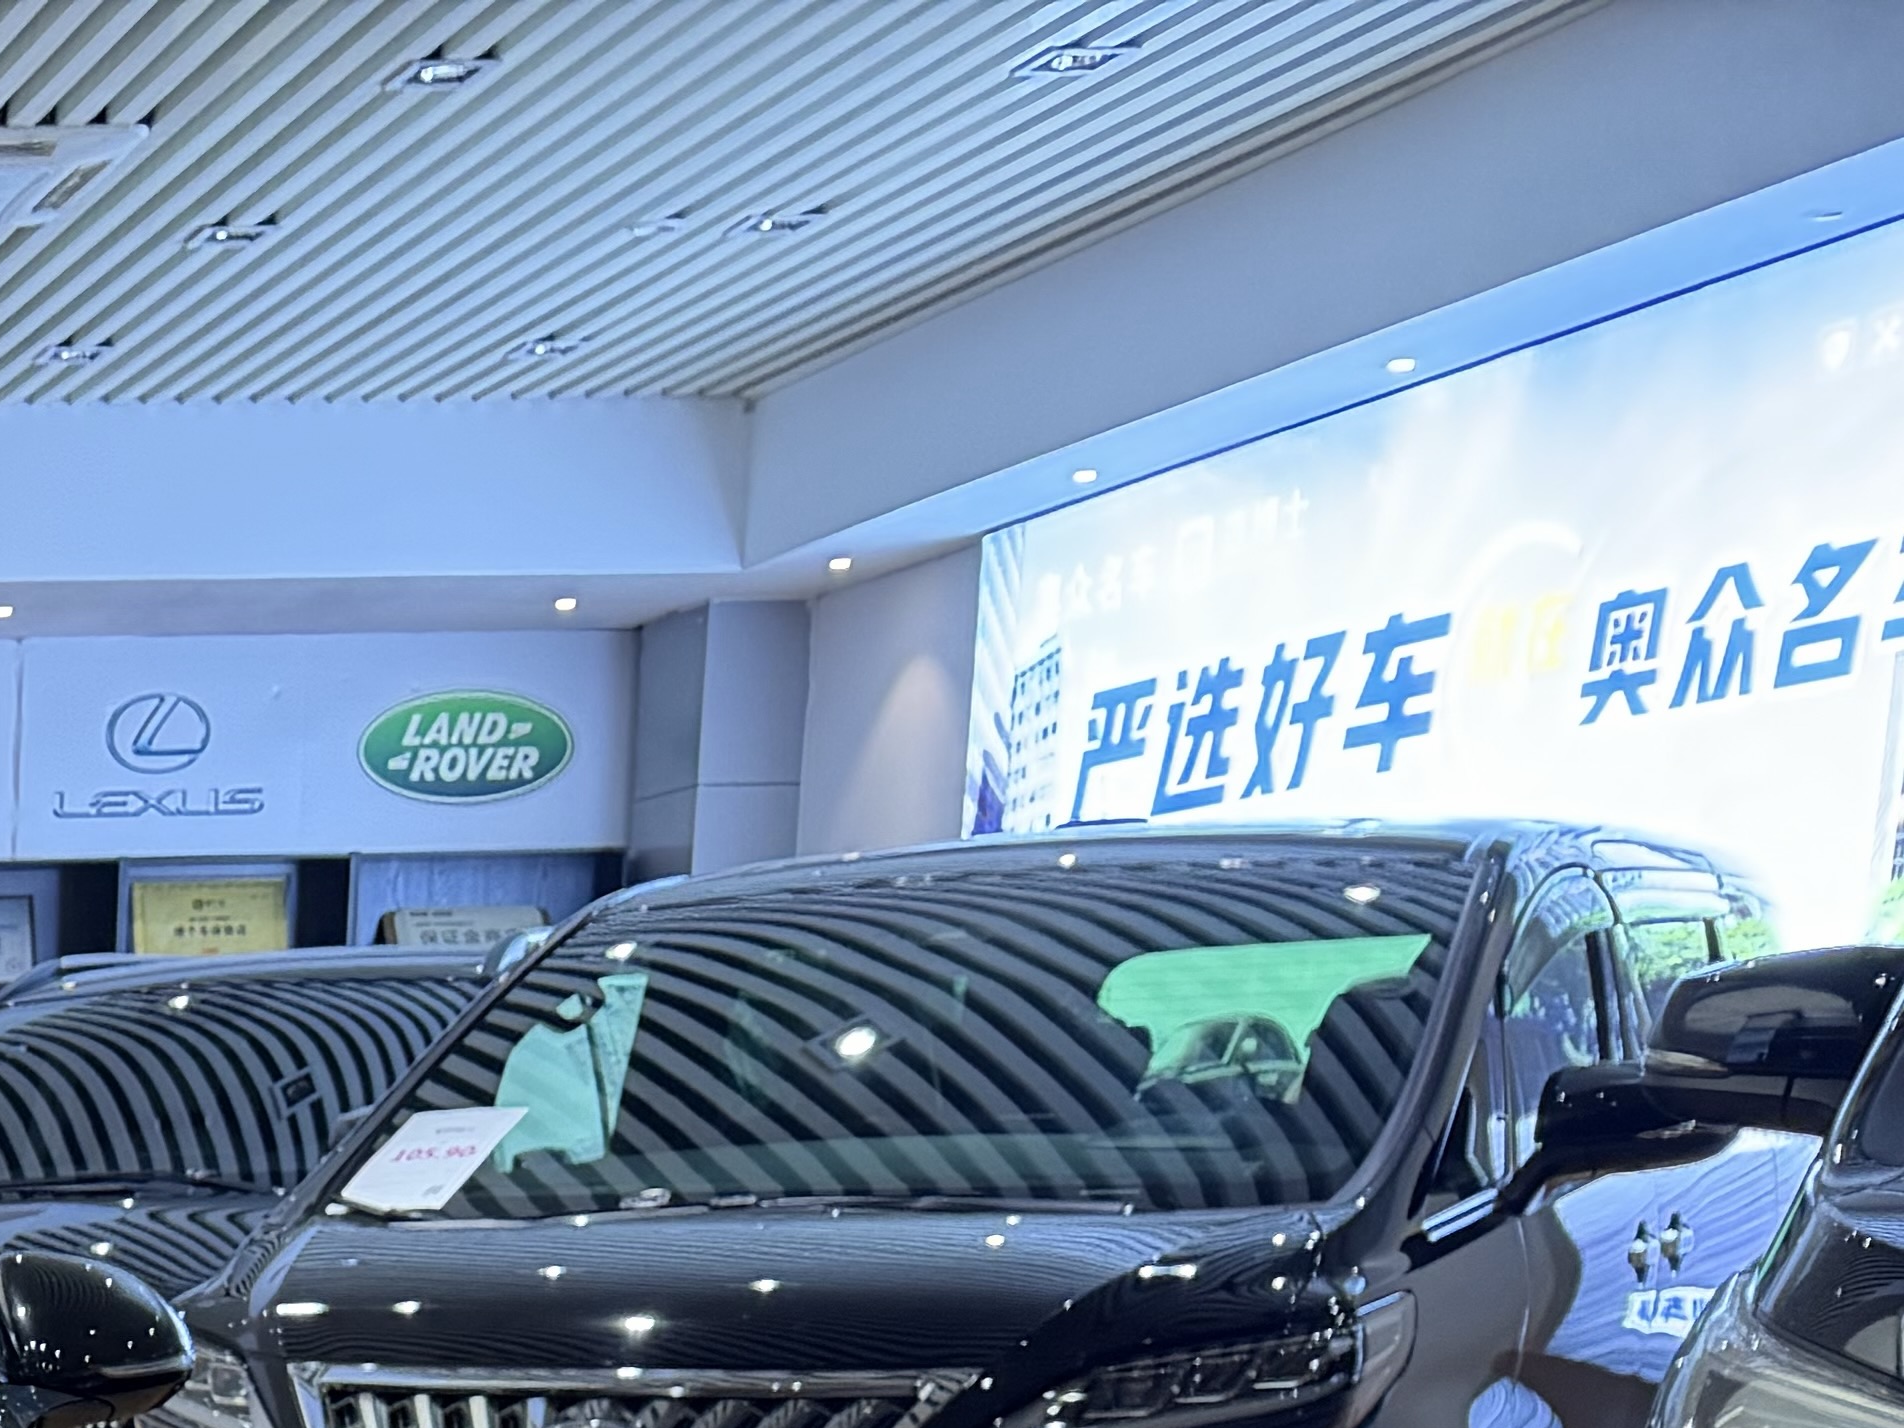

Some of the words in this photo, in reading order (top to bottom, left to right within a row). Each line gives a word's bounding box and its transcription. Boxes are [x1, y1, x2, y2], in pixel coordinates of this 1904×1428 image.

[1072, 611, 1452, 822] 严选好车
[1578, 536, 1904, 727] 奥众名
[401, 711, 506, 748] LAND
[409, 746, 540, 783] ROVER
[53, 787, 265, 819] LEXUS
